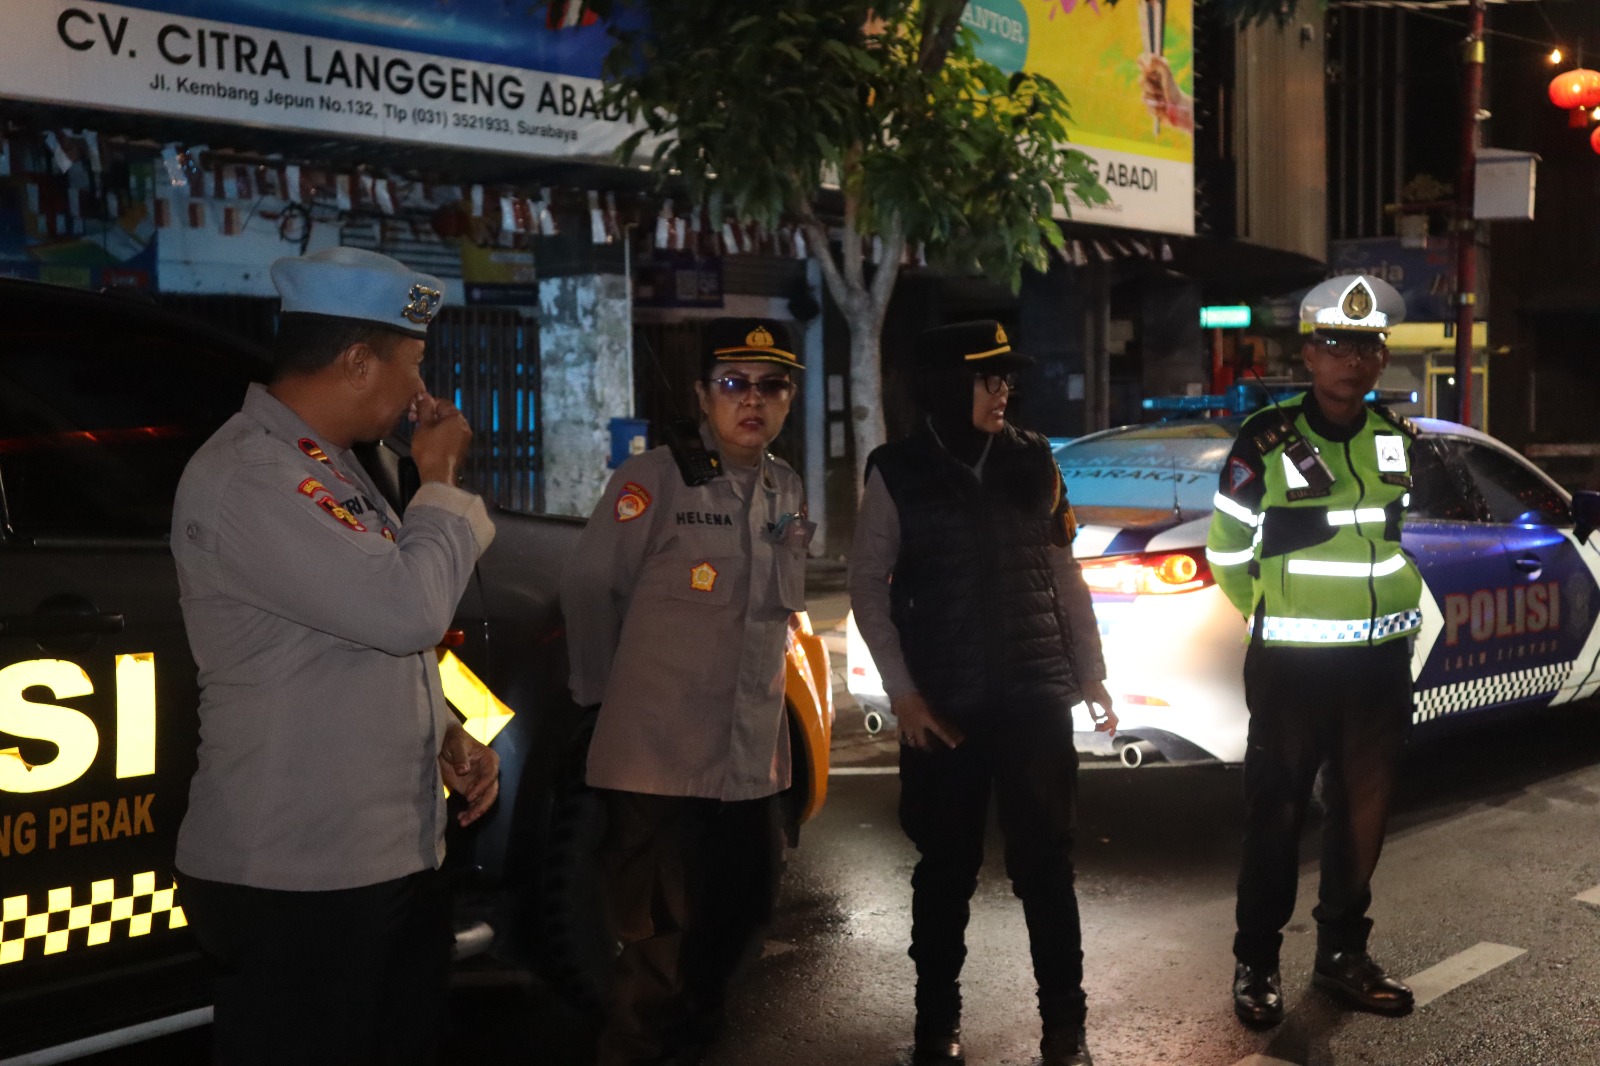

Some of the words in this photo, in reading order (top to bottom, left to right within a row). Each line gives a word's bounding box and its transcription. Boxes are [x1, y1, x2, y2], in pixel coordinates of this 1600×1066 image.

[958, 2, 1025, 44] ANTOR
[57, 8, 136, 58] CV.
[157, 24, 289, 80] CITRA
[304, 45, 525, 110] LANGGENG
[177, 77, 259, 106] Kembang
[264, 90, 315, 111] Jepun
[320, 96, 378, 120] No.132,
[384, 104, 408, 123] Tlp
[412, 107, 448, 128] (031)
[452, 113, 514, 135] 3521933,
[517, 121, 578, 143] Surabaya
[1105, 161, 1159, 192] ABADI
[1063, 467, 1207, 485] YARAKAT
[676, 511, 733, 526] HELENA
[1444, 581, 1561, 647] POLISI
[48, 793, 156, 850] PERAK
